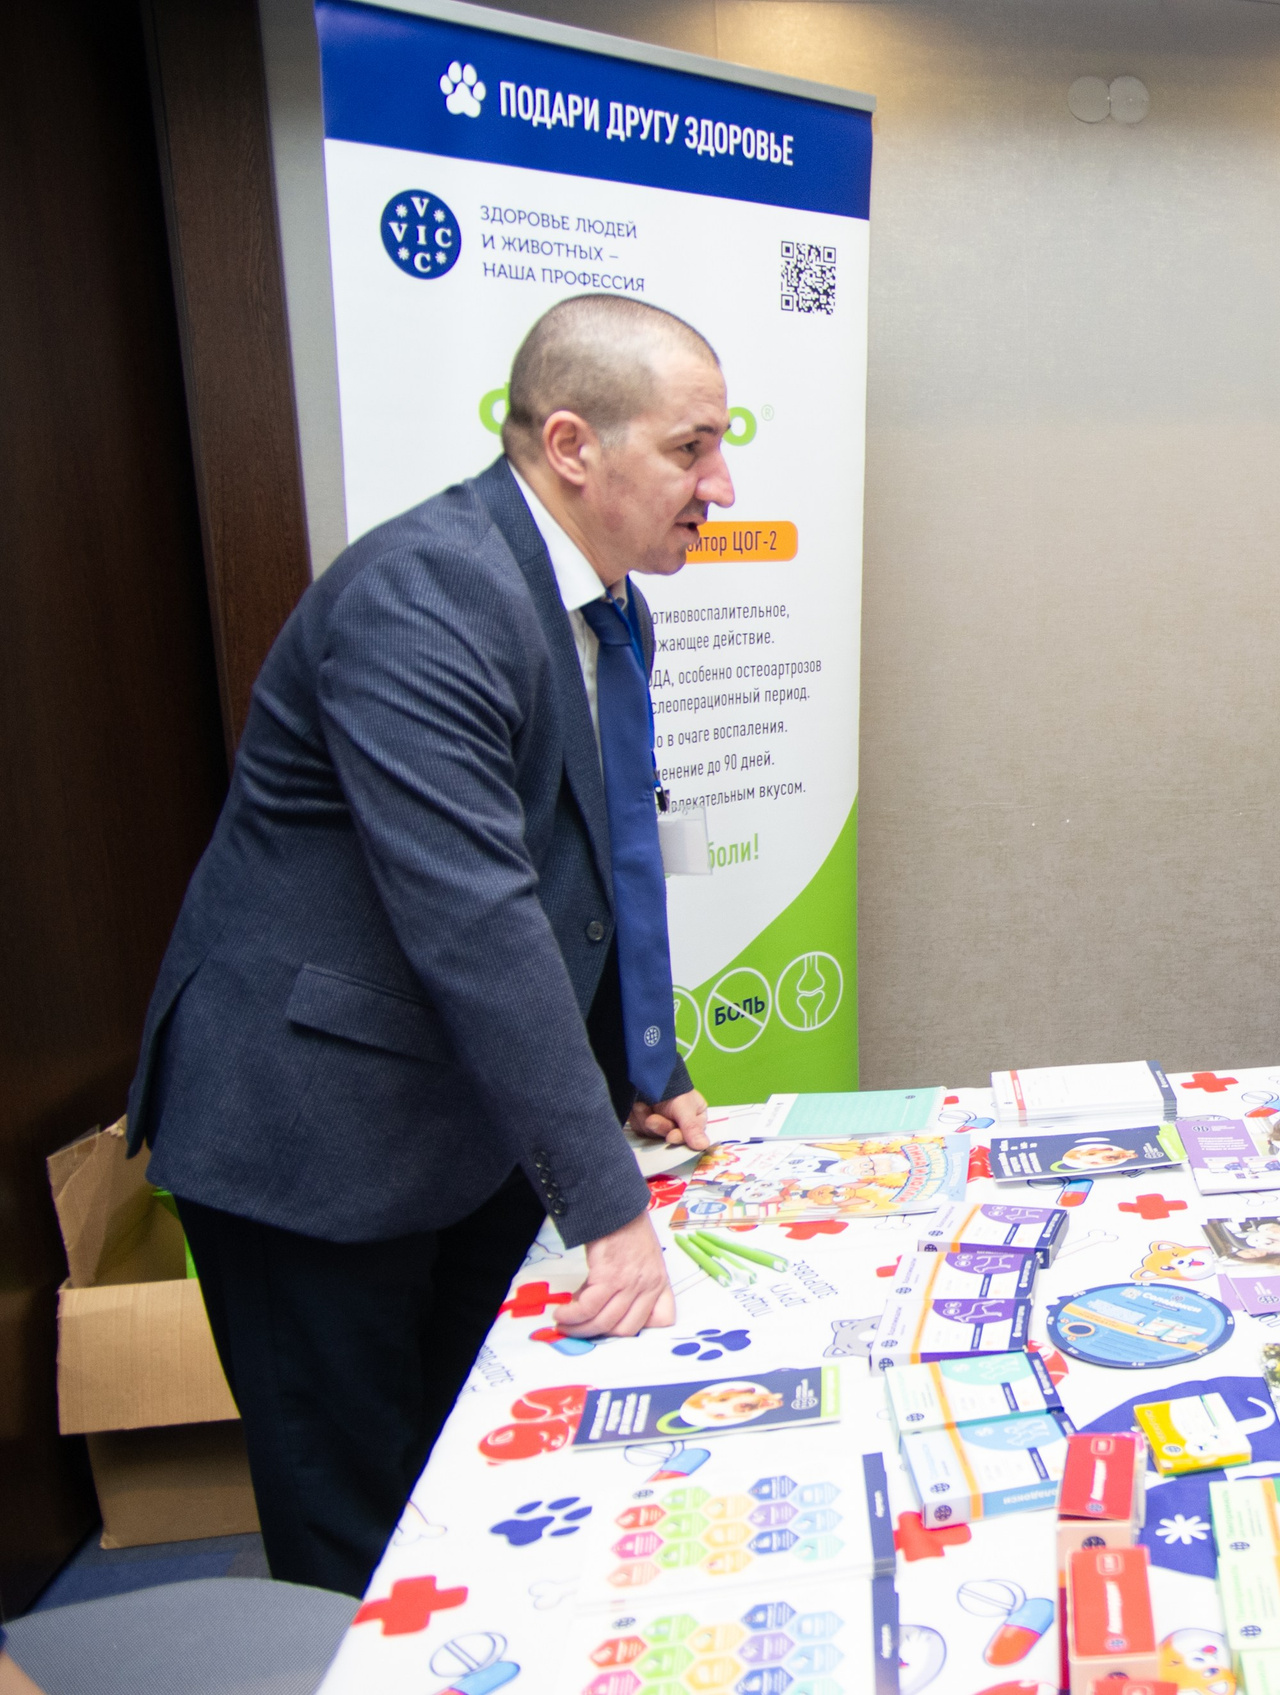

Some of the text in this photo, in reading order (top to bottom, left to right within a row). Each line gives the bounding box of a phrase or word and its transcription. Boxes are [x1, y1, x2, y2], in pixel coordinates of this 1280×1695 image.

[500, 81, 794, 166] ПОДАРИ ДРУГУ ЗДОРОВЬЕ
[480, 205, 637, 240] ЗДОРОВЬЕ ЛЮДЕЙ
[481, 234, 496, 250] И
[500, 237, 604, 262] ЖИВОТНЫХ
[483, 262, 645, 292] НАША ПРОФЕССИЯ
[733, 531, 777, 554] ЦОГ-2
[651, 604, 790, 626] отивовоспалительное,
[656, 630, 775, 653] жающее действие.
[678, 665, 732, 686] особенно
[736, 660, 822, 679] остеоартрозов
[651, 687, 810, 715] слеоперационный период.
[667, 734, 674, 747] в
[678, 730, 710, 745] очаге
[713, 721, 788, 740] воспаления.
[707, 760, 721, 777] до
[724, 753, 737, 772] 90
[740, 750, 775, 769] дней.
[759, 780, 806, 800] вкусом.
[714, 995, 766, 1026] БОЛЬ
[1002, 1487, 1058, 1504] оладокси
